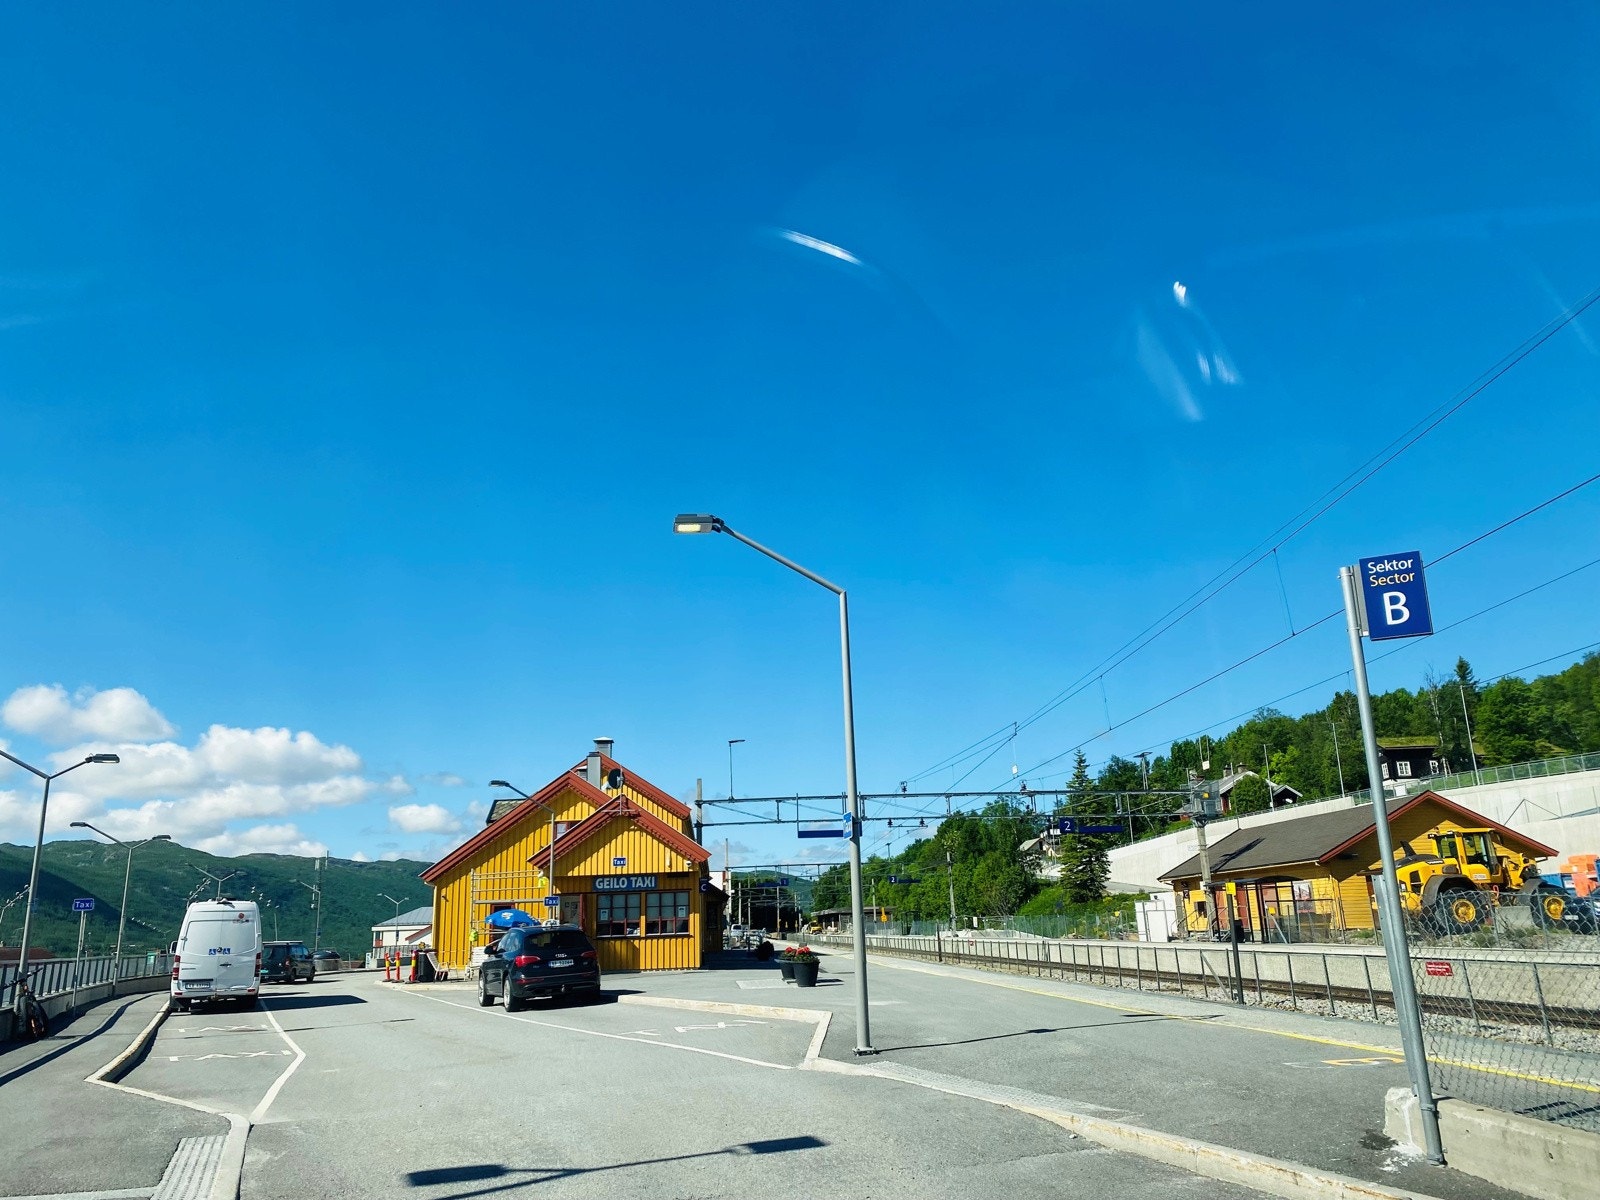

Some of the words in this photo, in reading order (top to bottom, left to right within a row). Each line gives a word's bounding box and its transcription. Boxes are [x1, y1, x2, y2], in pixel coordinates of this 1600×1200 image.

[1367, 558, 1414, 574] Sektor
[1369, 572, 1416, 587] Sector
[1383, 591, 1410, 626] B
[1064, 820, 1071, 831] 2
[595, 877, 628, 889] GEILO
[630, 876, 655, 888] TAXI
